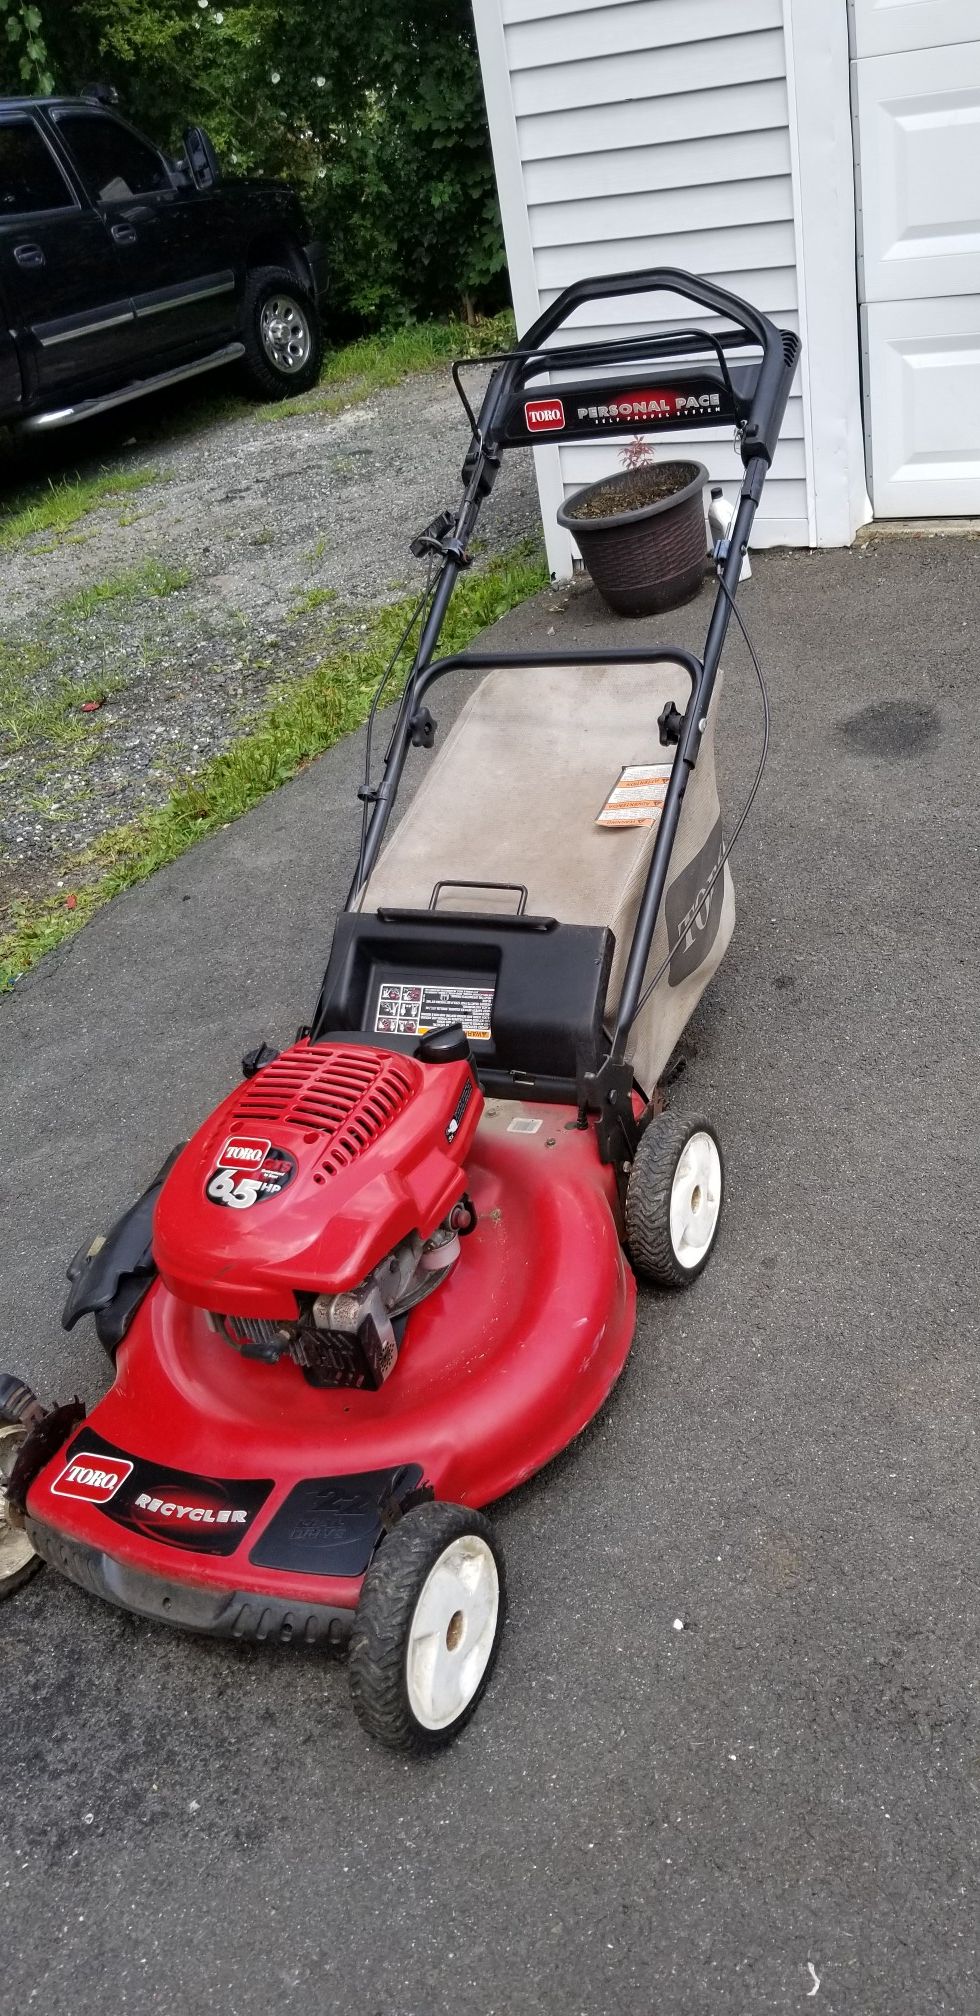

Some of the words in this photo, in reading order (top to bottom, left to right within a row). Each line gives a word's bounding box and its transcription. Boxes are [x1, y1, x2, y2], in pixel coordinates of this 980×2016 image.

[578, 400, 670, 419] PERSONAL
[675, 394, 720, 409] PACE
[261, 1182, 281, 1193] HP
[134, 1493, 248, 1523] RECYCLER
